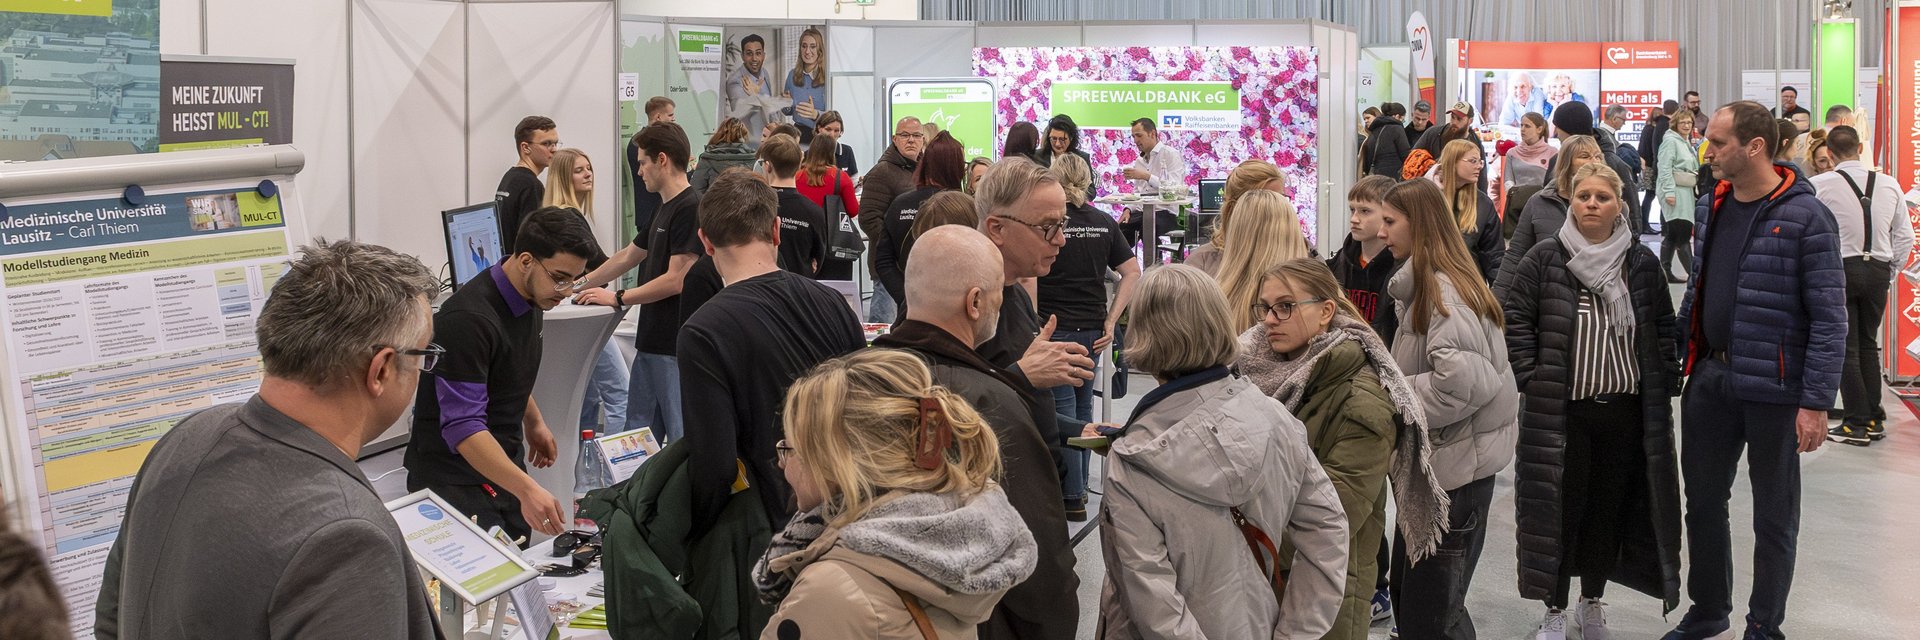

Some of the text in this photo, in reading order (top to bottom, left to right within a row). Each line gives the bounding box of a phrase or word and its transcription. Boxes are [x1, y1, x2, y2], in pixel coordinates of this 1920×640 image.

[1362, 78, 1372, 86] C4
[172, 86, 264, 105] MEINE ZUKUNFT
[625, 86, 635, 97] G5
[1063, 90, 1226, 104] SPREEWALDBANK eG
[1606, 92, 1659, 104] Mehr als
[173, 112, 215, 132] HEISST
[217, 111, 243, 130] MUL
[252, 110, 269, 128] CT!
[967, 145, 983, 156] der
[0, 203, 167, 230] Medizinische Universität
[243, 211, 277, 223] MUL-CT
[2, 230, 52, 246] Lausitz
[68, 226, 96, 239] Carl
[98, 222, 140, 236] Thiem
[3, 252, 107, 273] Modellstudiengang
[109, 249, 150, 261] Medizin
